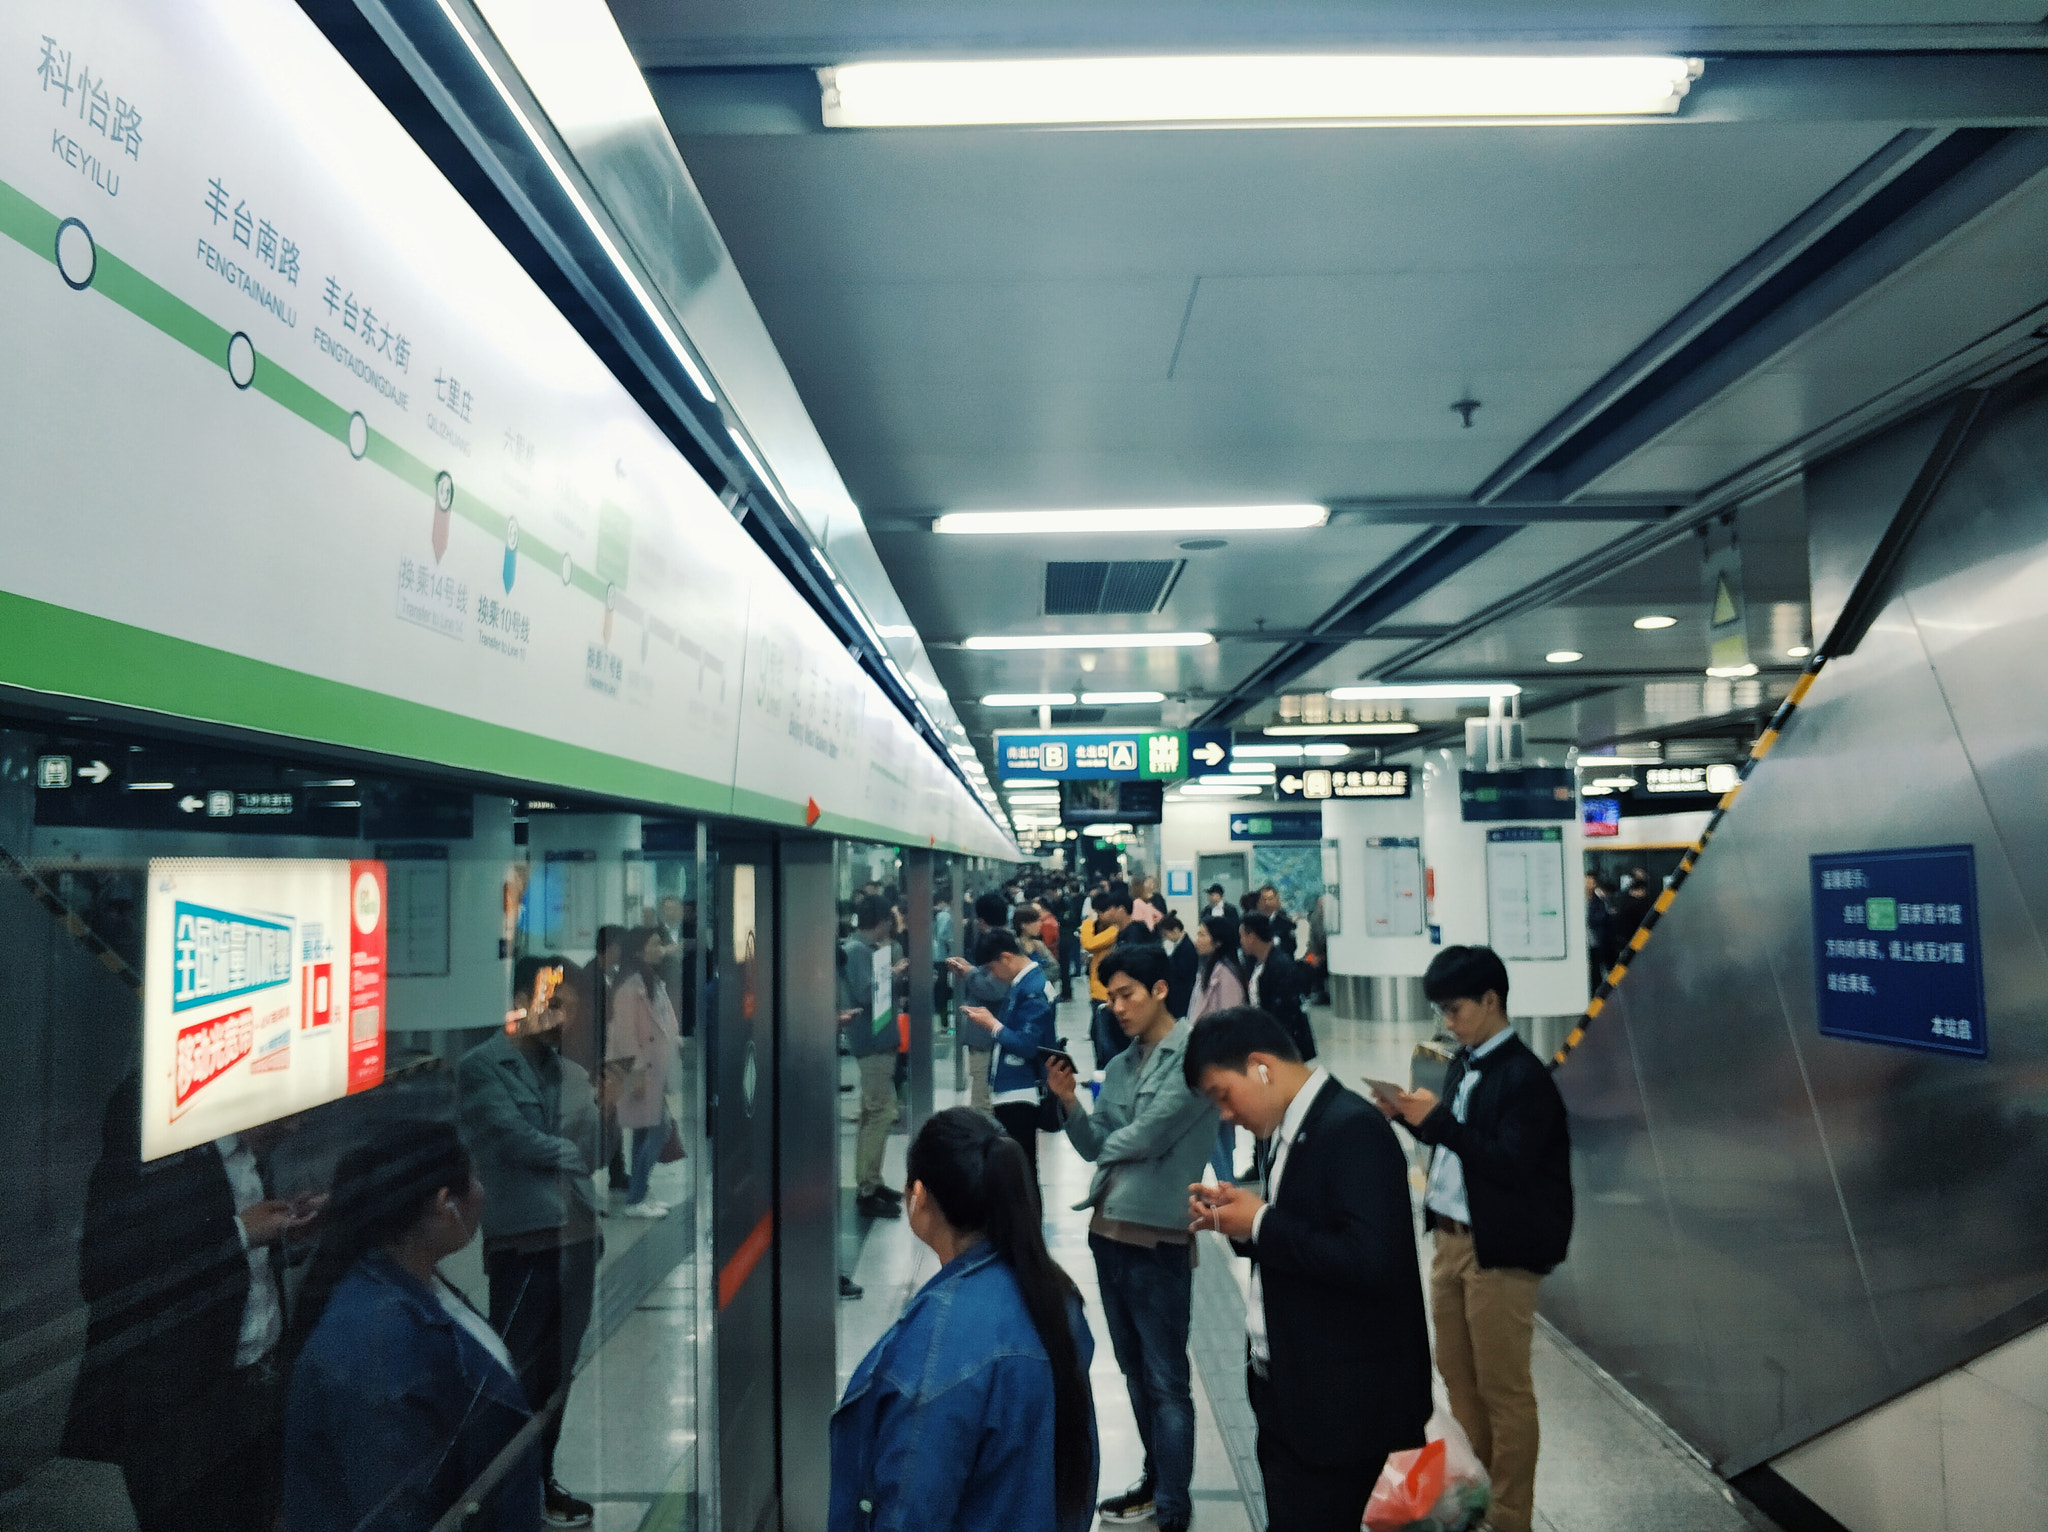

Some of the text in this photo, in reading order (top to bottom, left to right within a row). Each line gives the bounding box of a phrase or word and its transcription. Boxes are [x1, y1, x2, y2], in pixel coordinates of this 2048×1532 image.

[37, 34, 143, 161] 科怡路
[52, 128, 119, 197] KEYILU
[204, 177, 300, 288] 丰台南路
[197, 238, 297, 328] FENGTAINANLU
[323, 275, 411, 375] 丰台东大街
[434, 367, 474, 424] 七里庄
[401, 559, 468, 615] 换乘14号线
[401, 597, 431, 622] Transfer
[478, 593, 531, 644] 换乘10号线
[478, 629, 500, 651] Transfer
[1045, 747, 1062, 767] B
[1113, 744, 1132, 766] A
[1149, 761, 1178, 773] EXIT
